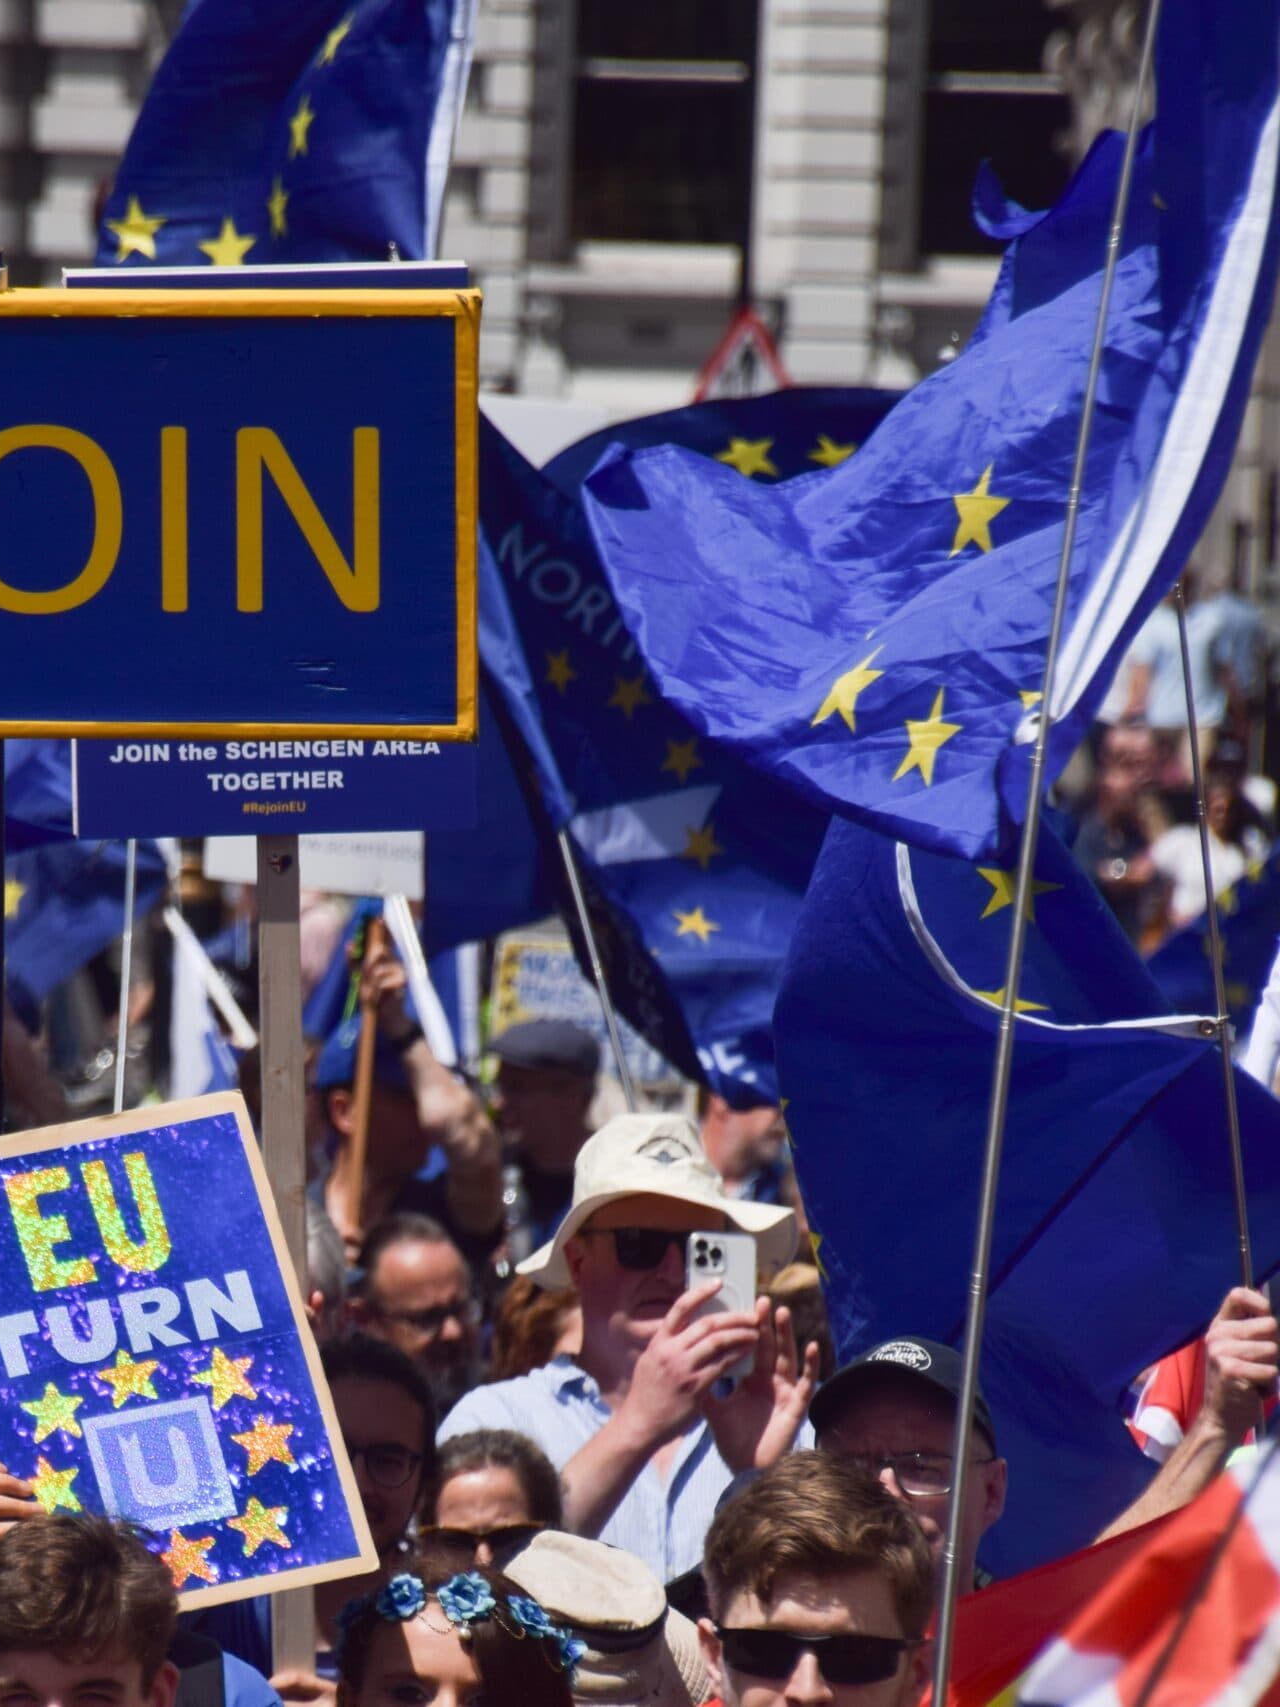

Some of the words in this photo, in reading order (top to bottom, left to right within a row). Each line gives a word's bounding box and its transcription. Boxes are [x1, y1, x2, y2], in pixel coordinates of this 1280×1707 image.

[109, 743, 171, 763] JOIN
[177, 743, 218, 762] the
[225, 739, 365, 760] SCHENGEN
[371, 739, 441, 757] AREA
[206, 770, 345, 792] TOGETHER
[242, 800, 307, 816] #RejoinEU
[3, 1151, 172, 1293] EU
[121, 1425, 200, 1507] U
